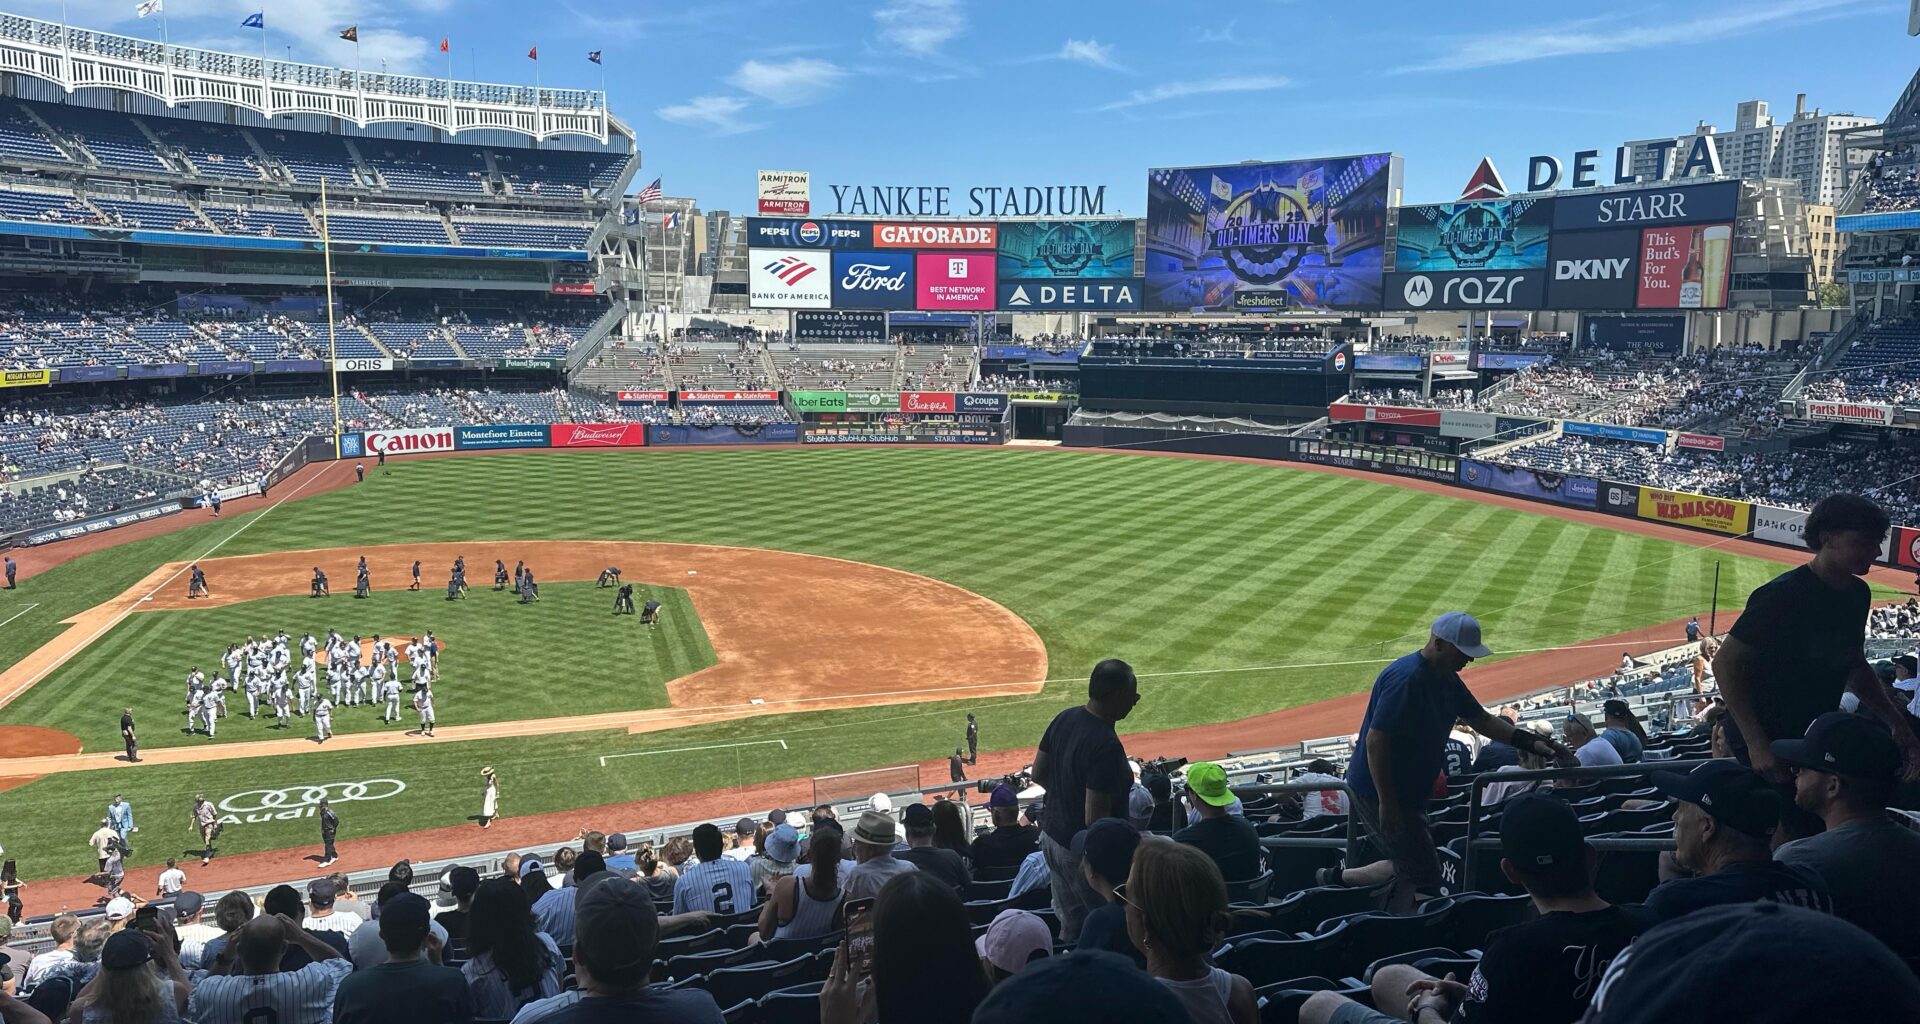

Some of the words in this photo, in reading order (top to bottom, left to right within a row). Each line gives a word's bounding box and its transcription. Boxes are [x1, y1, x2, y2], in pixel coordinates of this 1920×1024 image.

[1527, 135, 1723, 192] DELTA
[760, 174, 807, 184] ARMITRON
[763, 201, 805, 209] ARMITRON
[828, 184, 951, 216] YANKEE
[968, 184, 1107, 216] STADIUM
[1598, 192, 1687, 223] STARR
[760, 227, 790, 236] PEPSI
[831, 229, 860, 238] PEPSI
[880, 226, 992, 244] GATORADE
[1217, 224, 1284, 247] OLD-TIMERS'
[1289, 222, 1311, 243] DAY
[1488, 227, 1503, 241] DAY
[1646, 233, 1676, 247] This
[1080, 243, 1094, 254] DAY
[1645, 247, 1681, 261] Bud's
[1555, 258, 1631, 281] DKNY
[1644, 262, 1666, 275] For
[841, 263, 907, 292] Ford
[1643, 276, 1671, 289] You.
[1878, 272, 1890, 281] CUP
[751, 292, 776, 300] BANK
[790, 293, 830, 301] AMERICA
[929, 286, 948, 294] BEST
[949, 286, 986, 294] NETWORK
[1040, 285, 1134, 304] DELTA
[1443, 276, 1525, 305] razr
[945, 294, 979, 302] AMERICA
[1237, 294, 1284, 307] freshdirect
[1626, 341, 1642, 349] THE
[345, 359, 382, 370] ORIS
[505, 359, 529, 369] Poland
[529, 360, 552, 369] Spring
[820, 397, 845, 407] Eats
[974, 397, 999, 406] coupa
[1809, 404, 1836, 416] Parts
[1838, 405, 1886, 420] Authority
[462, 429, 508, 440] Montefiore
[509, 428, 544, 438] Einstein
[573, 427, 624, 440] Budweiser
[807, 435, 836, 443] StubHub
[869, 434, 899, 442] StubHub
[366, 432, 452, 453] Canon
[1680, 436, 1706, 446] Reebok
[1333, 457, 1354, 467] STARR
[1395, 465, 1416, 475] StubHub
[1416, 468, 1436, 478] StubHub
[1436, 471, 1455, 482] StubHub
[1571, 483, 1598, 495] freshdirec
[1756, 517, 1787, 531] BANK
[1789, 522, 1804, 533] OF
[1446, 753, 1462, 776] 2
[217, 806, 316, 825] Audi
[711, 881, 736, 914] 2
